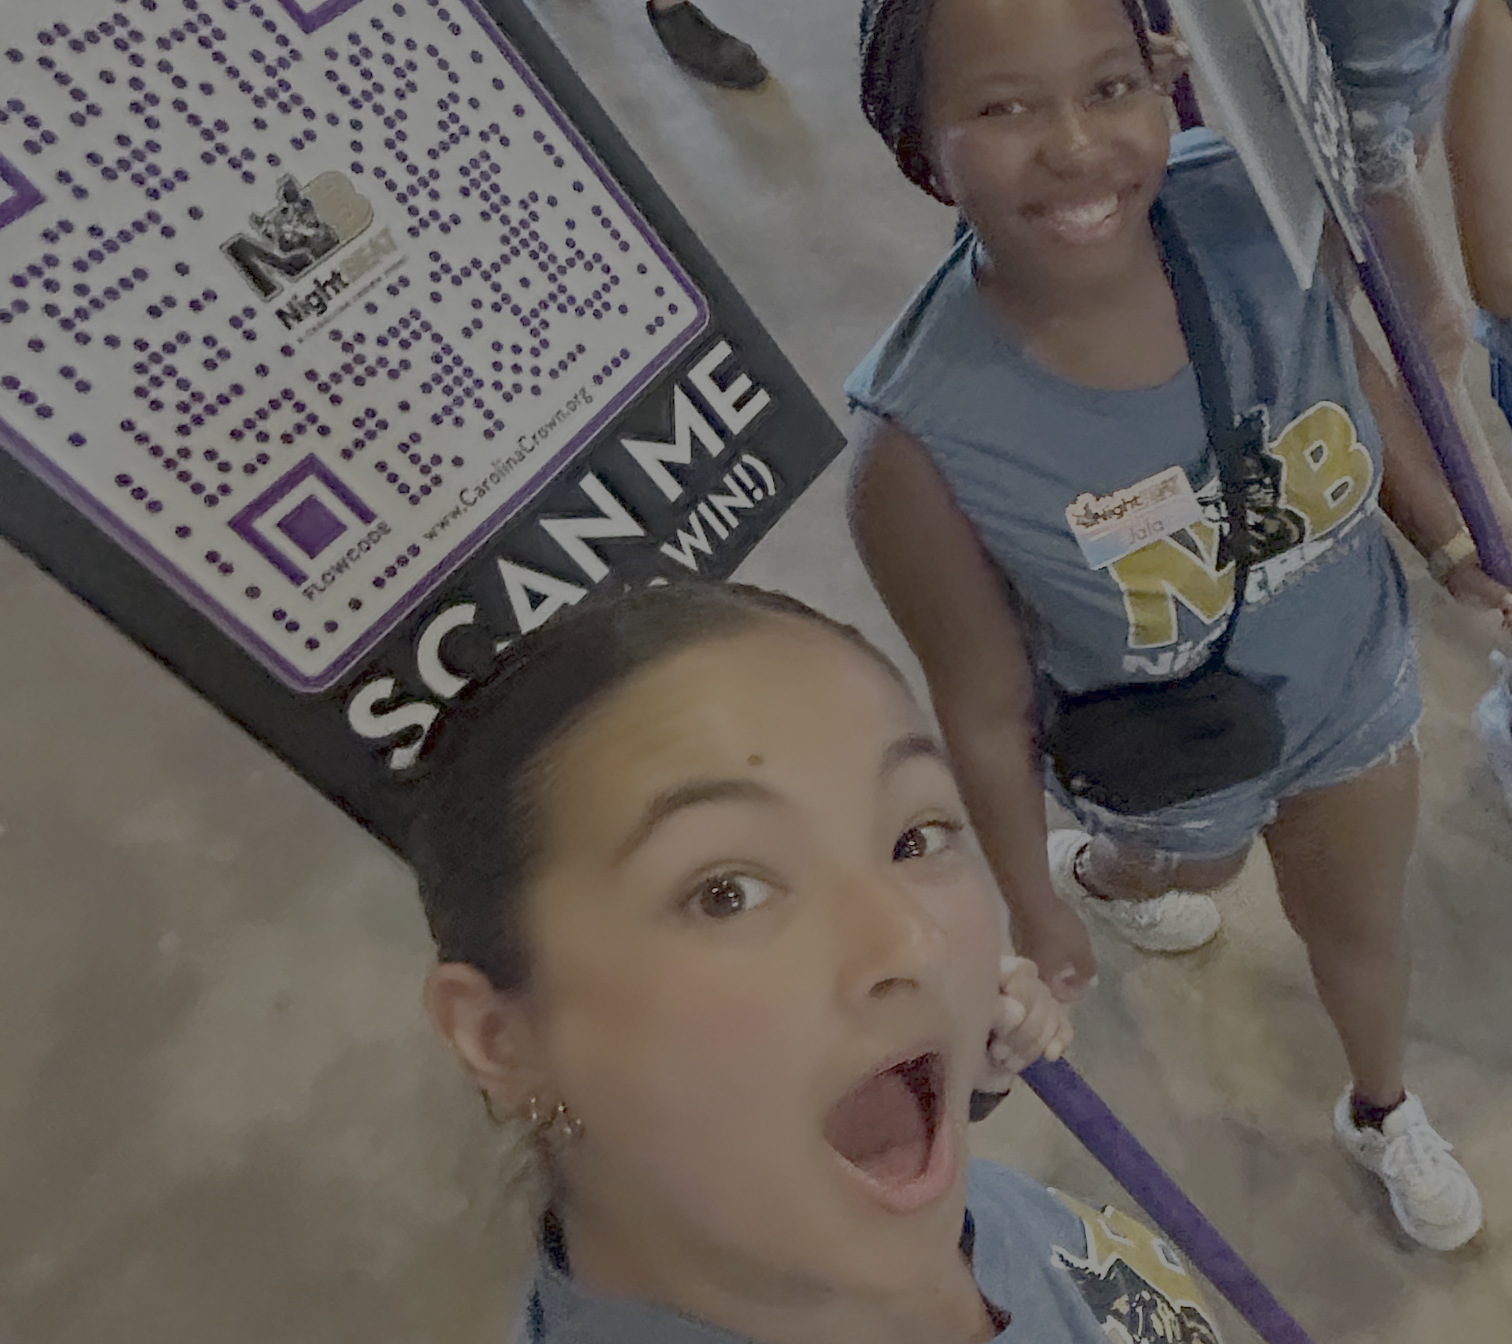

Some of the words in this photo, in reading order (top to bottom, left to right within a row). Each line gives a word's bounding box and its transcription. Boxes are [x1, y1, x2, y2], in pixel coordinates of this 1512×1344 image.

[423, 386, 594, 541] www.CarolinaCrown.org
[660, 453, 777, 572] WIN!)
[348, 471, 646, 770] SCAN
[620, 340, 772, 502] ME
